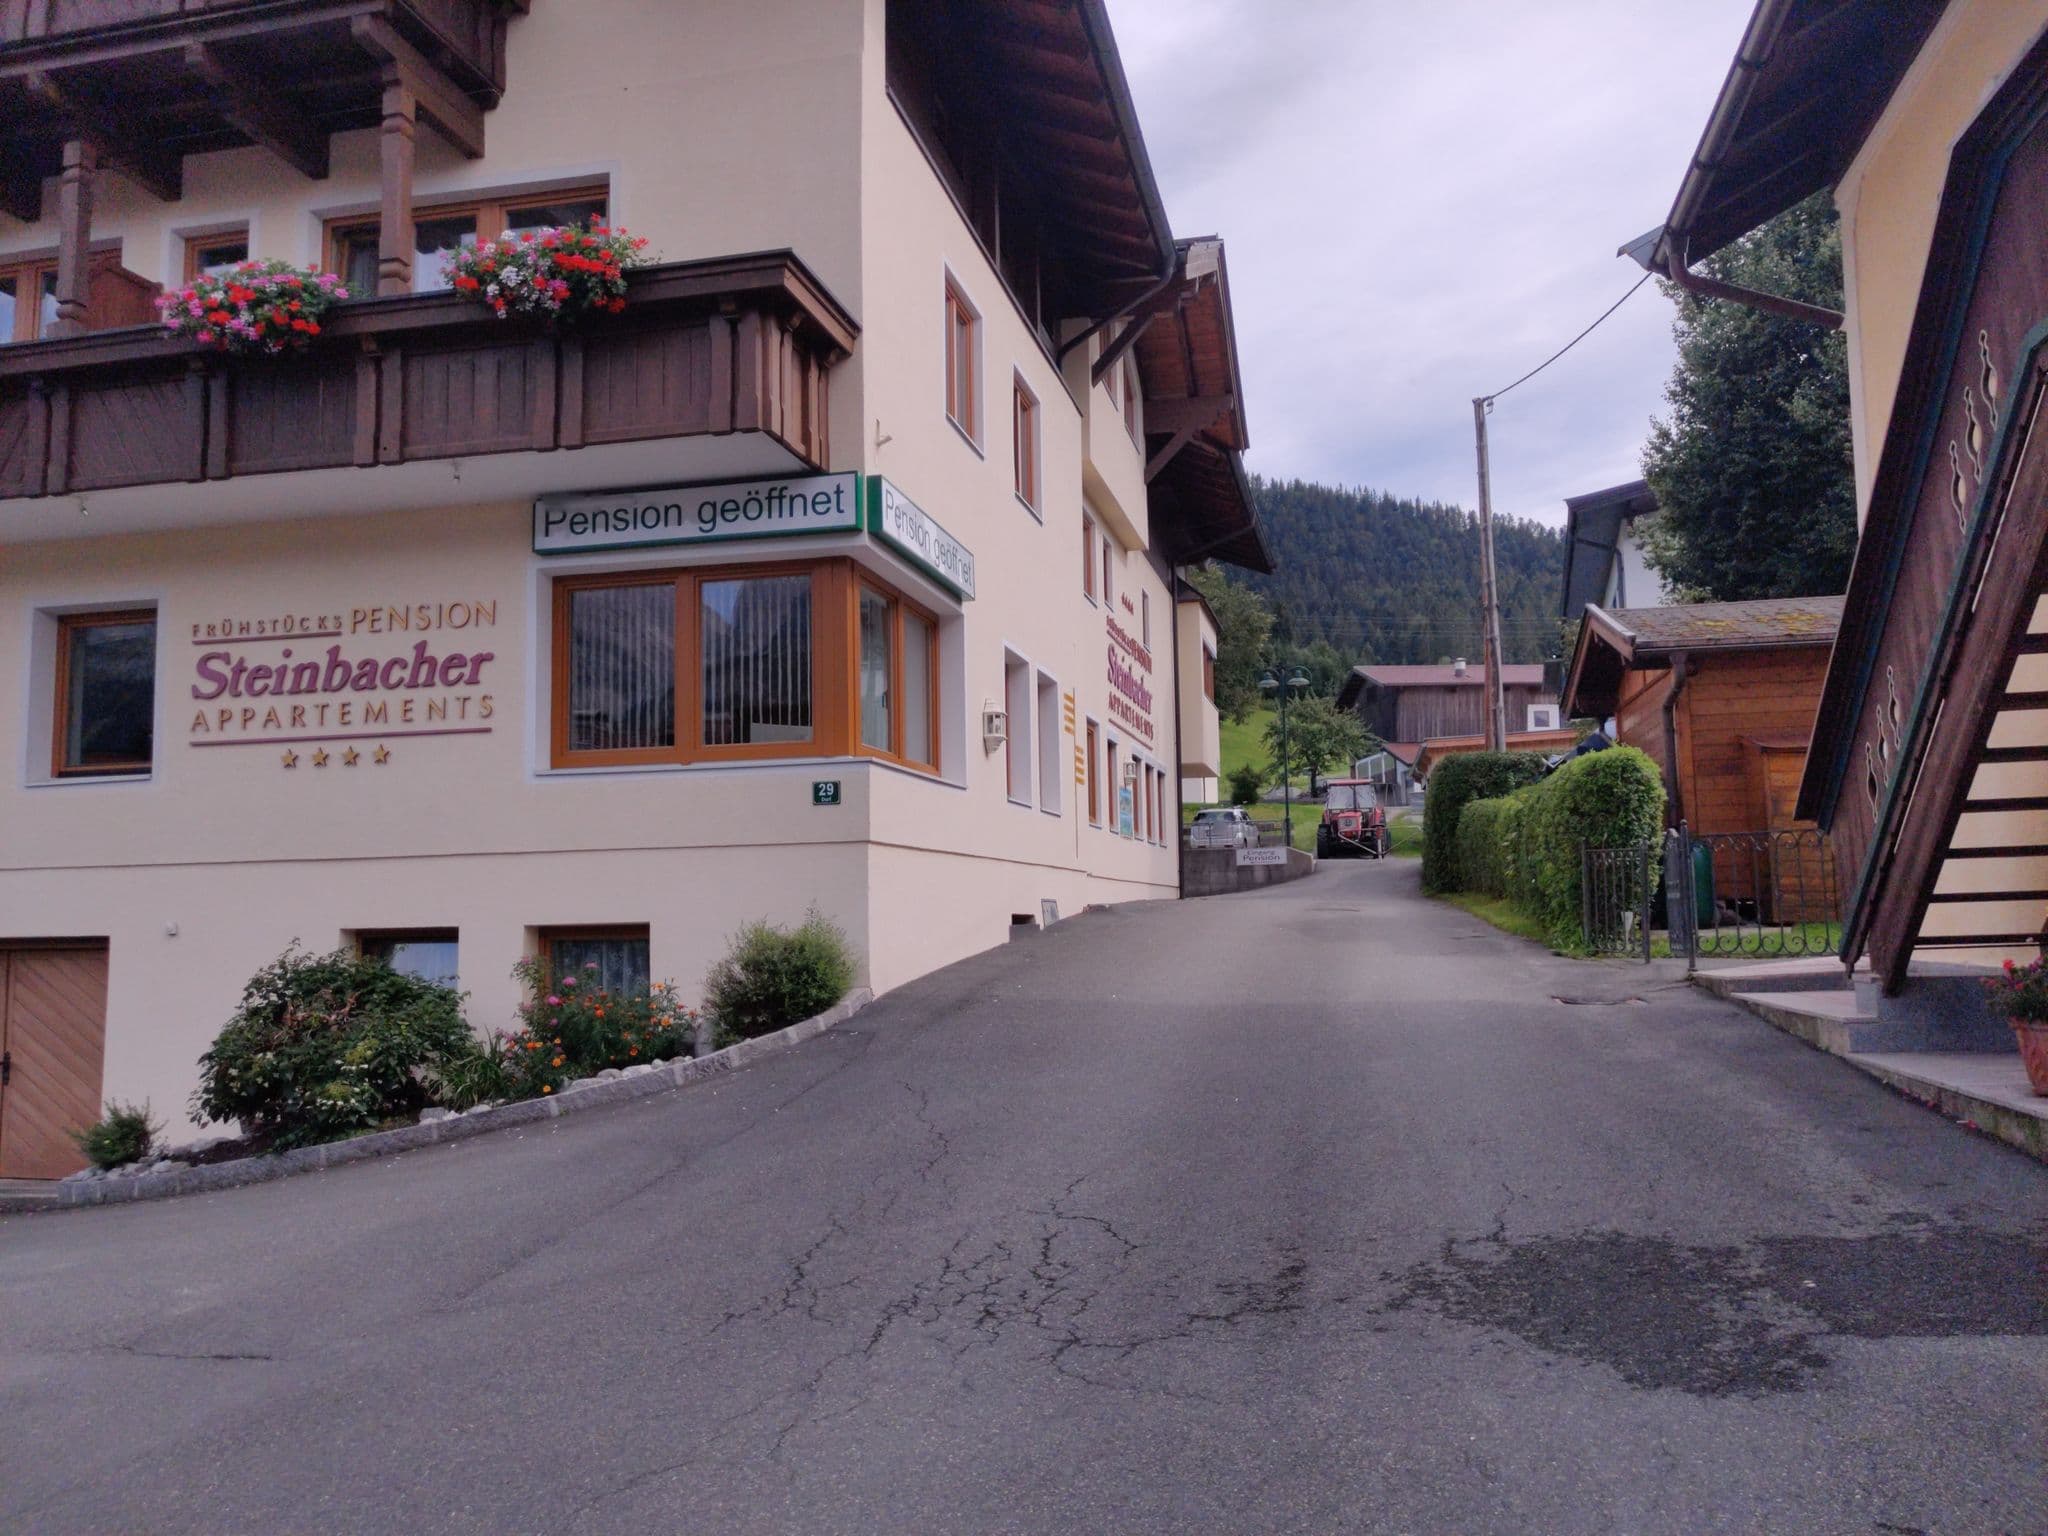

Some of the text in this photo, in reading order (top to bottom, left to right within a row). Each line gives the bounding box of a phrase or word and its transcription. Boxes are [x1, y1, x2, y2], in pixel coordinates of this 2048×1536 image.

[545, 481, 845, 538] Pension geöffnet
[885, 488, 973, 587] Pension geöffnet
[191, 599, 498, 638] FRÜHSTÜCKS PENSION
[191, 640, 495, 701] Steinbacher
[190, 695, 495, 733] APPARTEMENTS
[818, 783, 834, 797] 29
